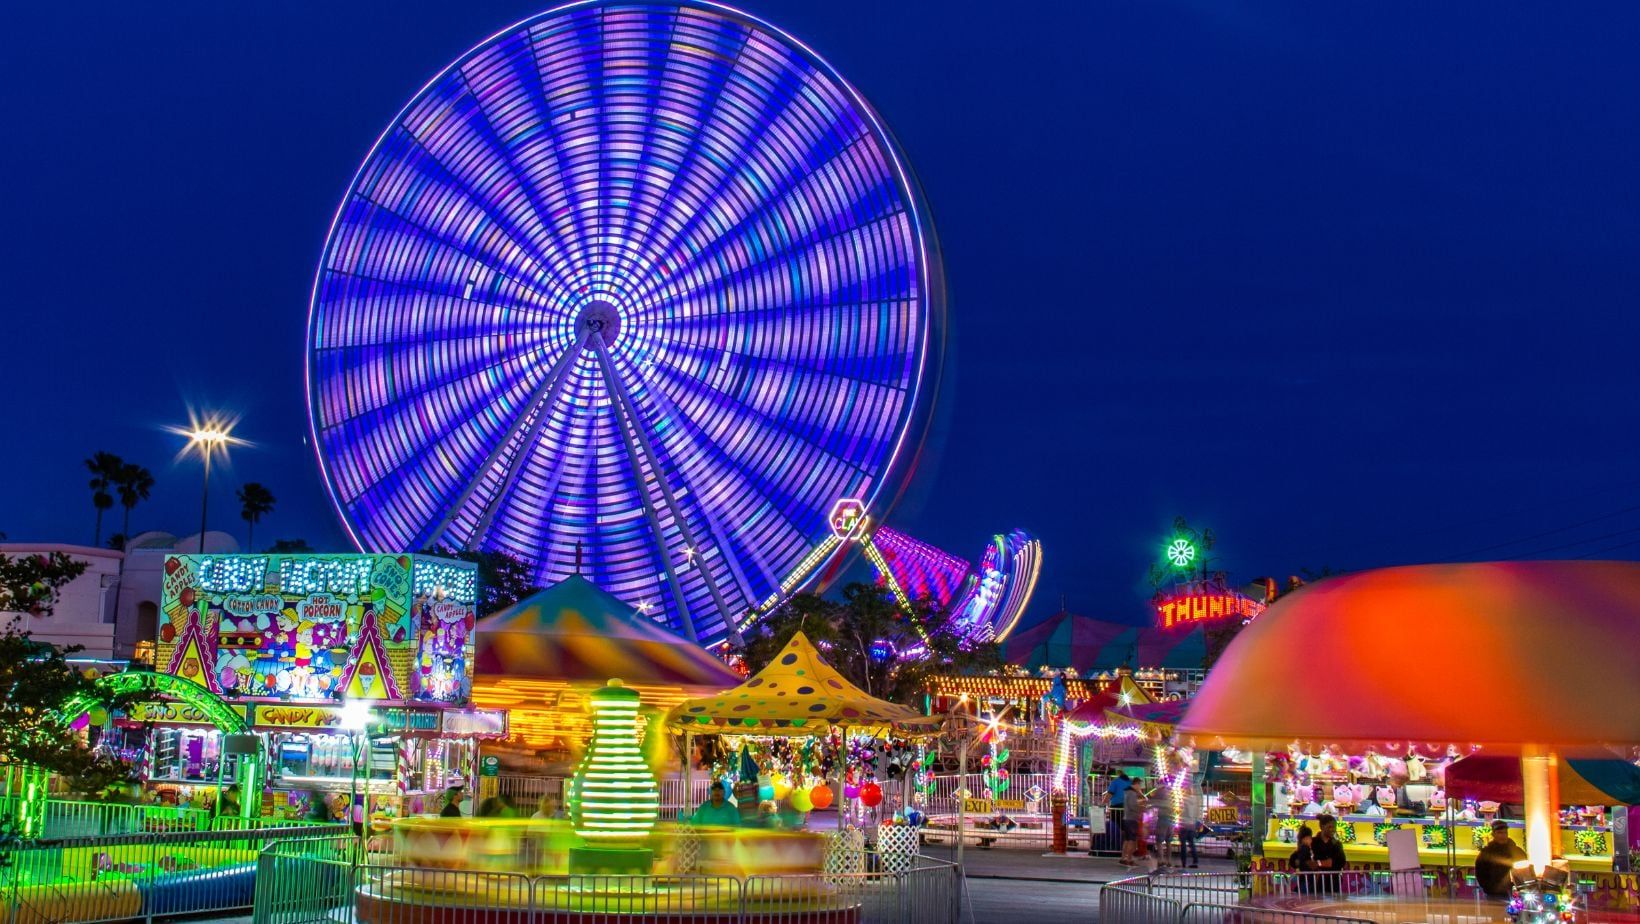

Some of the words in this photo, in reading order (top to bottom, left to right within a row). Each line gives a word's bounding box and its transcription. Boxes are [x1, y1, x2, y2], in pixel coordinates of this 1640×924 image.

[165, 563, 189, 591] CANDY
[199, 557, 268, 594] CANDY
[280, 557, 374, 596] FACTORY
[384, 564, 403, 585] SNO
[169, 573, 196, 599] APPLES
[373, 572, 400, 599] CONES
[229, 599, 254, 613] COTTON
[256, 598, 279, 611] CANDY
[312, 596, 329, 605] HOT
[436, 603, 454, 613] CANDY
[303, 604, 341, 618] POPCORN
[445, 608, 465, 619] APPLES
[145, 704, 177, 720] SNO
[262, 708, 314, 725] CANDY
[964, 800, 987, 812] EXIT
[1209, 808, 1237, 821] ENTER
